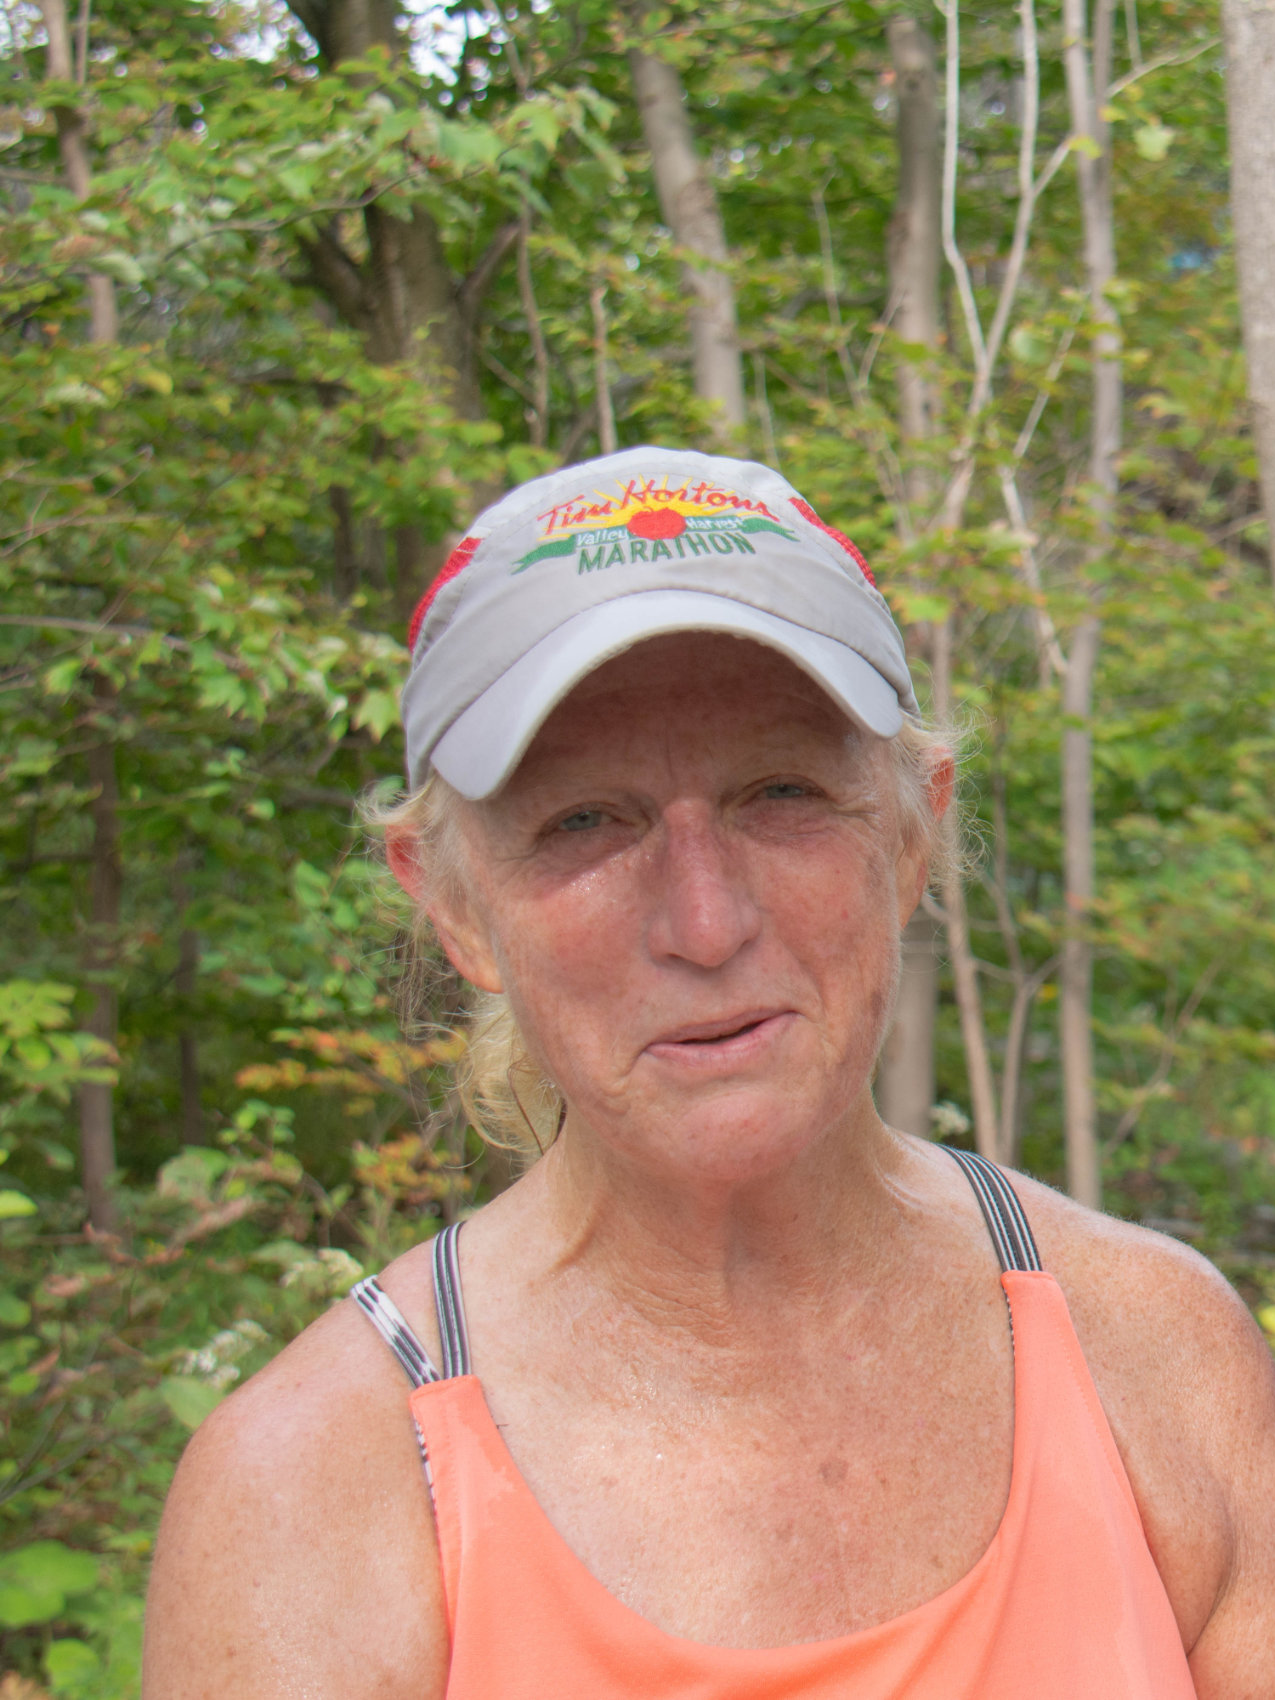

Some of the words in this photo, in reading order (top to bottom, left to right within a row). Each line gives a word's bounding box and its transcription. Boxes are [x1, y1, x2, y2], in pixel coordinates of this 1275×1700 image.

[537, 495, 613, 535] Tim
[620, 480, 780, 523] Hortons
[576, 528, 630, 547] Valley
[686, 516, 744, 531] Harvest
[576, 531, 757, 575] MARATHON
